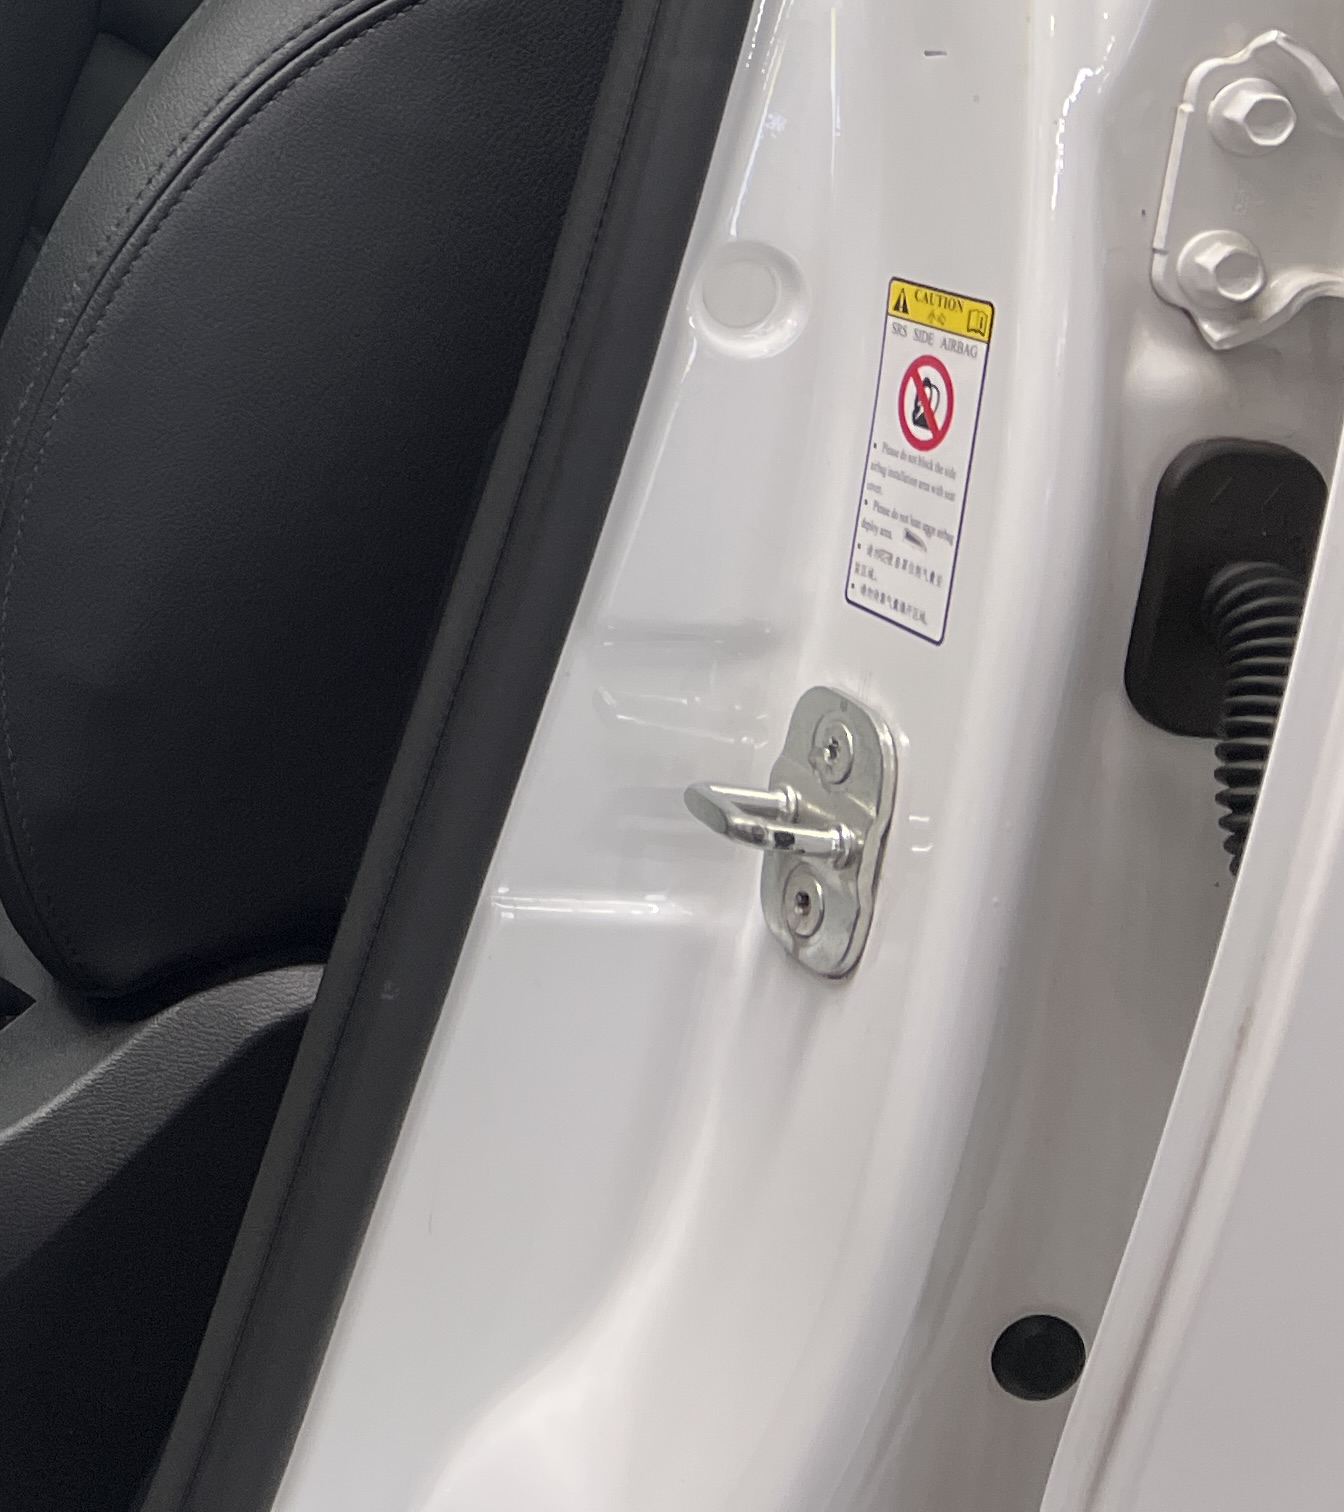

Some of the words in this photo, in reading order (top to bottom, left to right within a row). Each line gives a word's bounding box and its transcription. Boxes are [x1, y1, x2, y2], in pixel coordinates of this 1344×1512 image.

[914, 288, 964, 313] CAUTION
[892, 322, 908, 338] SRS
[913, 328, 935, 346] SIDE
[940, 338, 978, 358] AIRBAG
